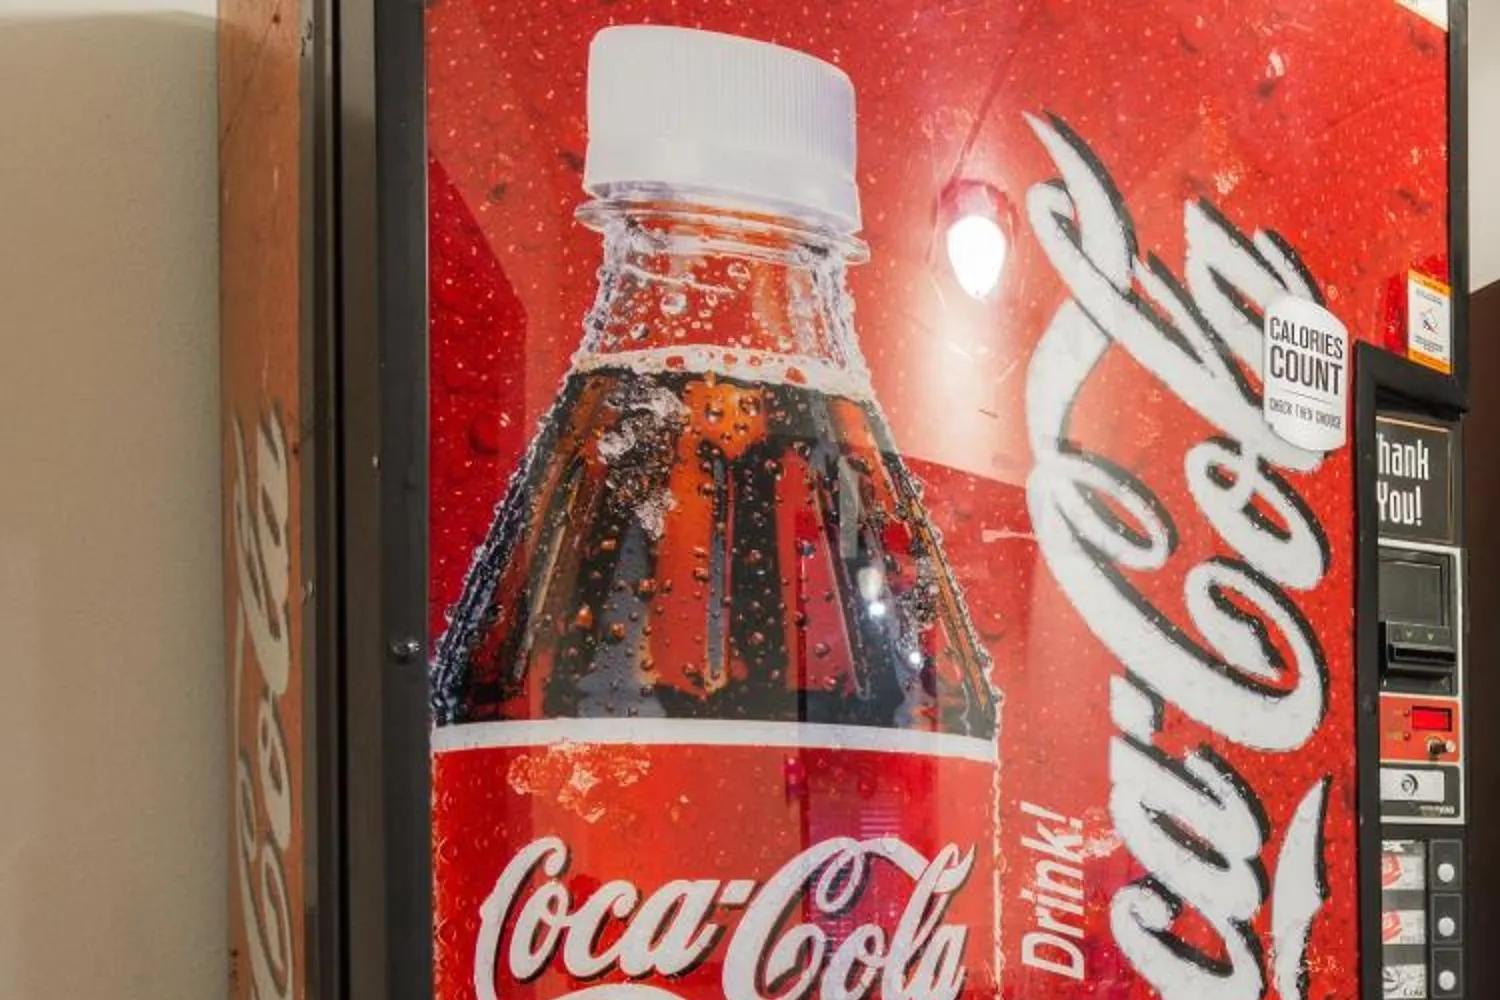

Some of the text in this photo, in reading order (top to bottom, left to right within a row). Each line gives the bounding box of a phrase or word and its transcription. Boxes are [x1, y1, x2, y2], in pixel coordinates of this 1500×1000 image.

[1269, 317, 1343, 360] CALORIES
[1269, 344, 1342, 396] COUNT
[1021, 801, 1084, 980] Drink!
